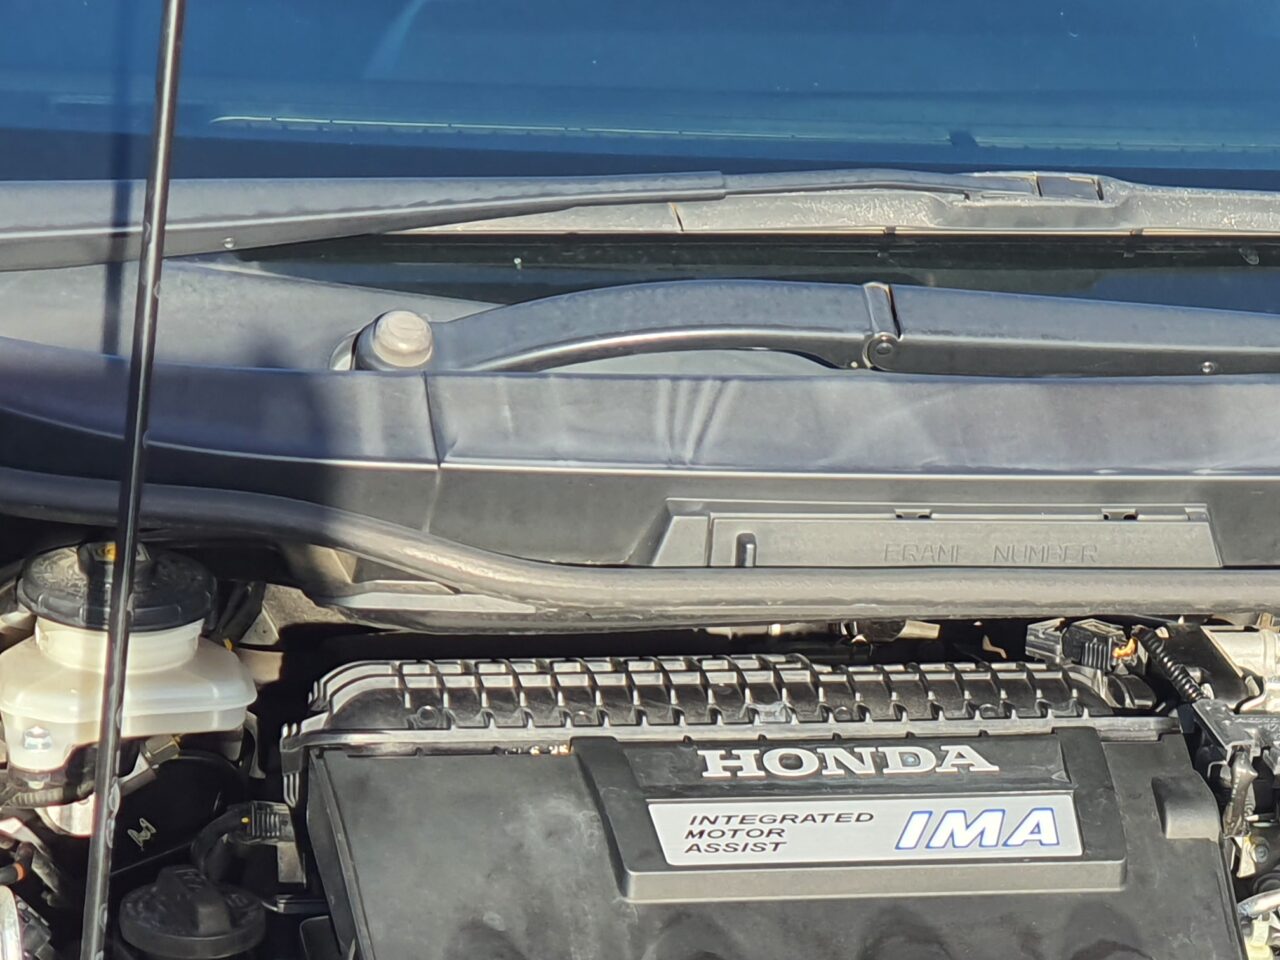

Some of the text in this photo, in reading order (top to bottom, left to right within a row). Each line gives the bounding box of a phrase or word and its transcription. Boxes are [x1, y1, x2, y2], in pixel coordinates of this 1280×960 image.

[992, 543, 1099, 563] NUMBER
[697, 745, 999, 778] HONDA
[688, 811, 875, 826] INTEGRATED
[685, 827, 786, 840] MOTOR
[895, 807, 1061, 850] IMA
[685, 841, 788, 854] ASSIST
